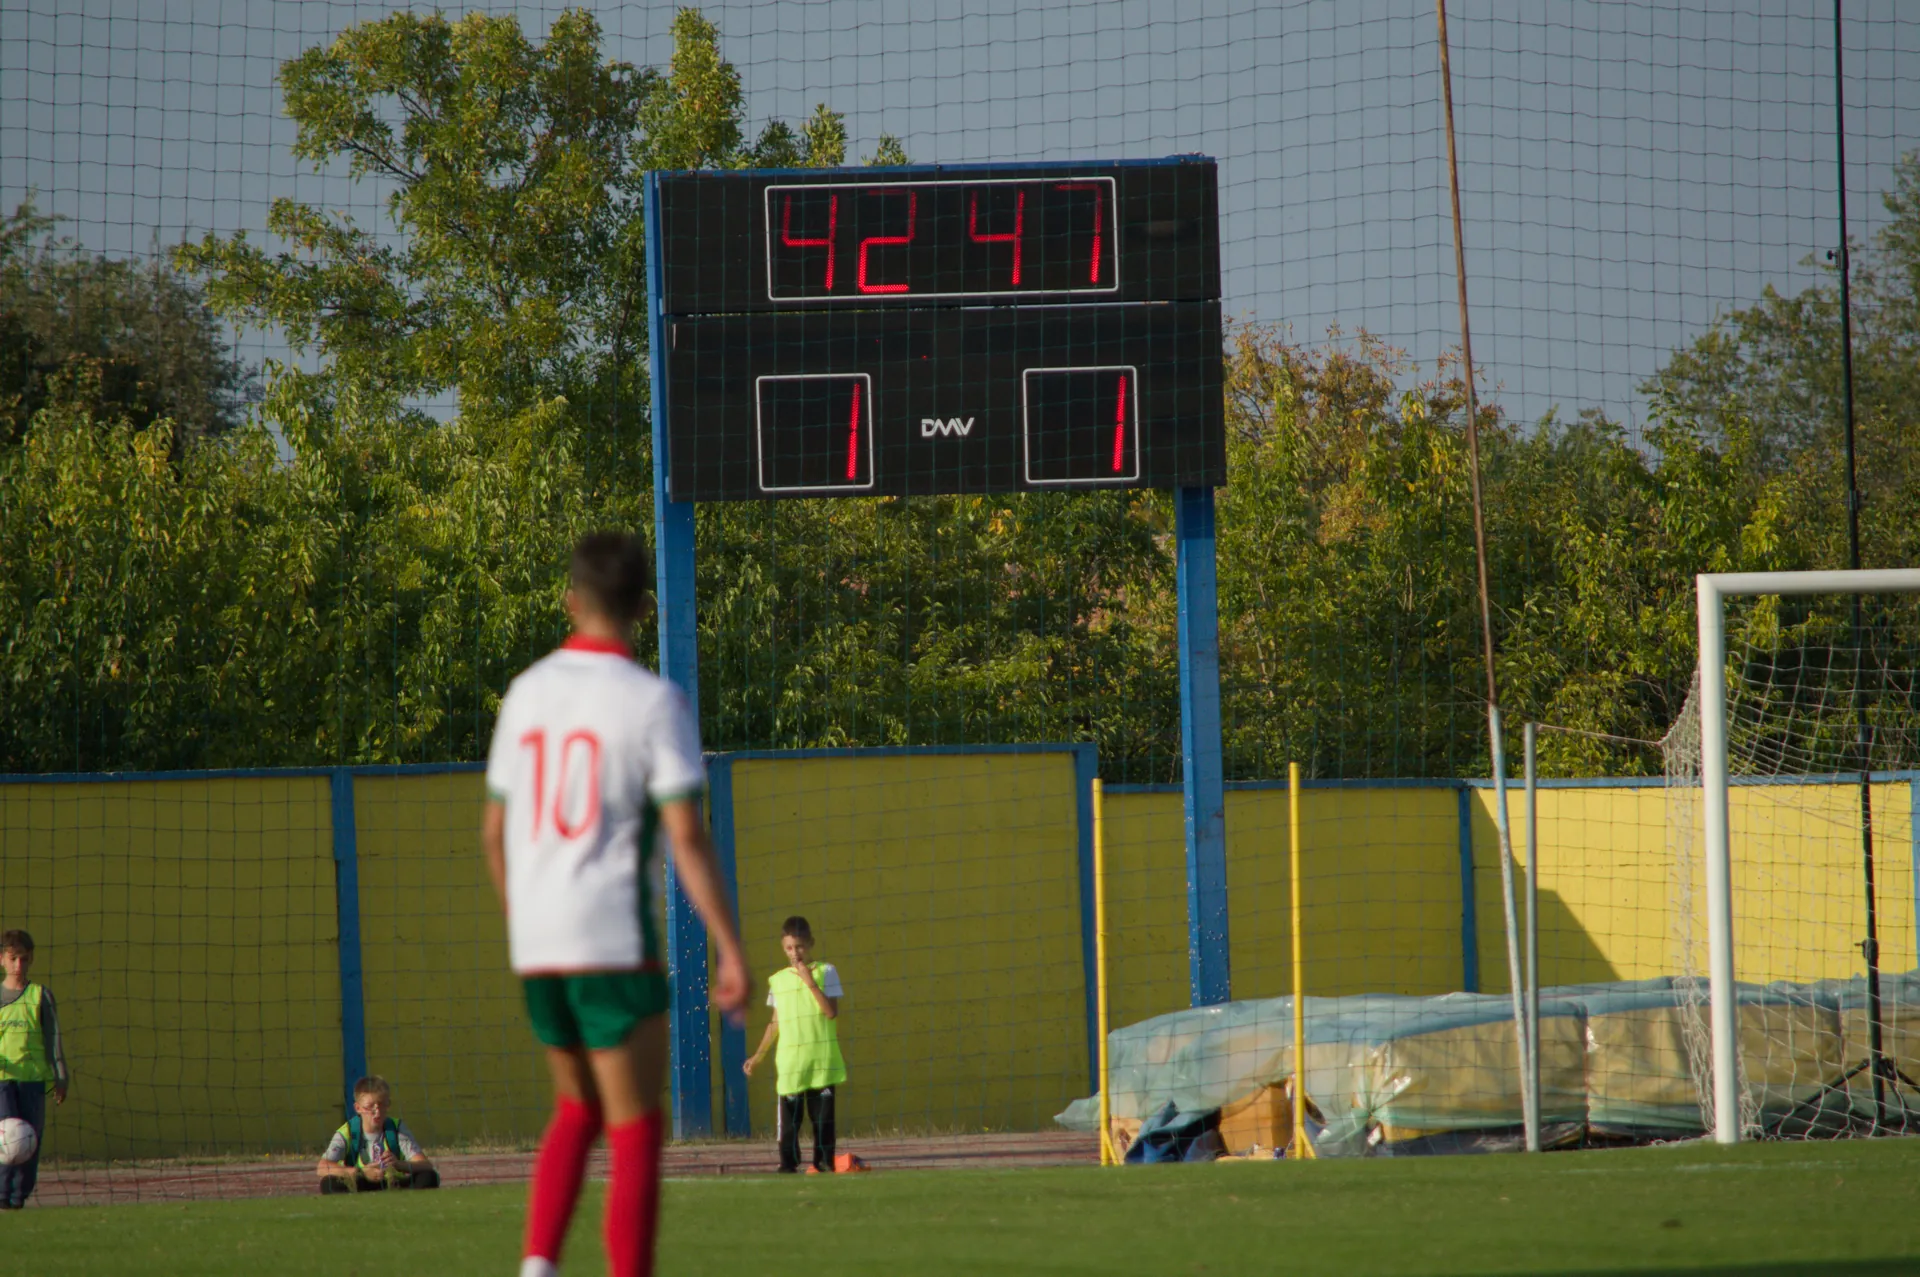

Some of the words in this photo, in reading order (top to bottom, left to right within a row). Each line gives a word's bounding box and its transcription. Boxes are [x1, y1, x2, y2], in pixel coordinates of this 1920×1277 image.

[782, 188, 917, 293] 42
[969, 184, 1102, 286] 47
[846, 383, 860, 480] 1
[921, 417, 975, 437] DMV
[1112, 376, 1127, 472] 1
[518, 724, 603, 842] 10
